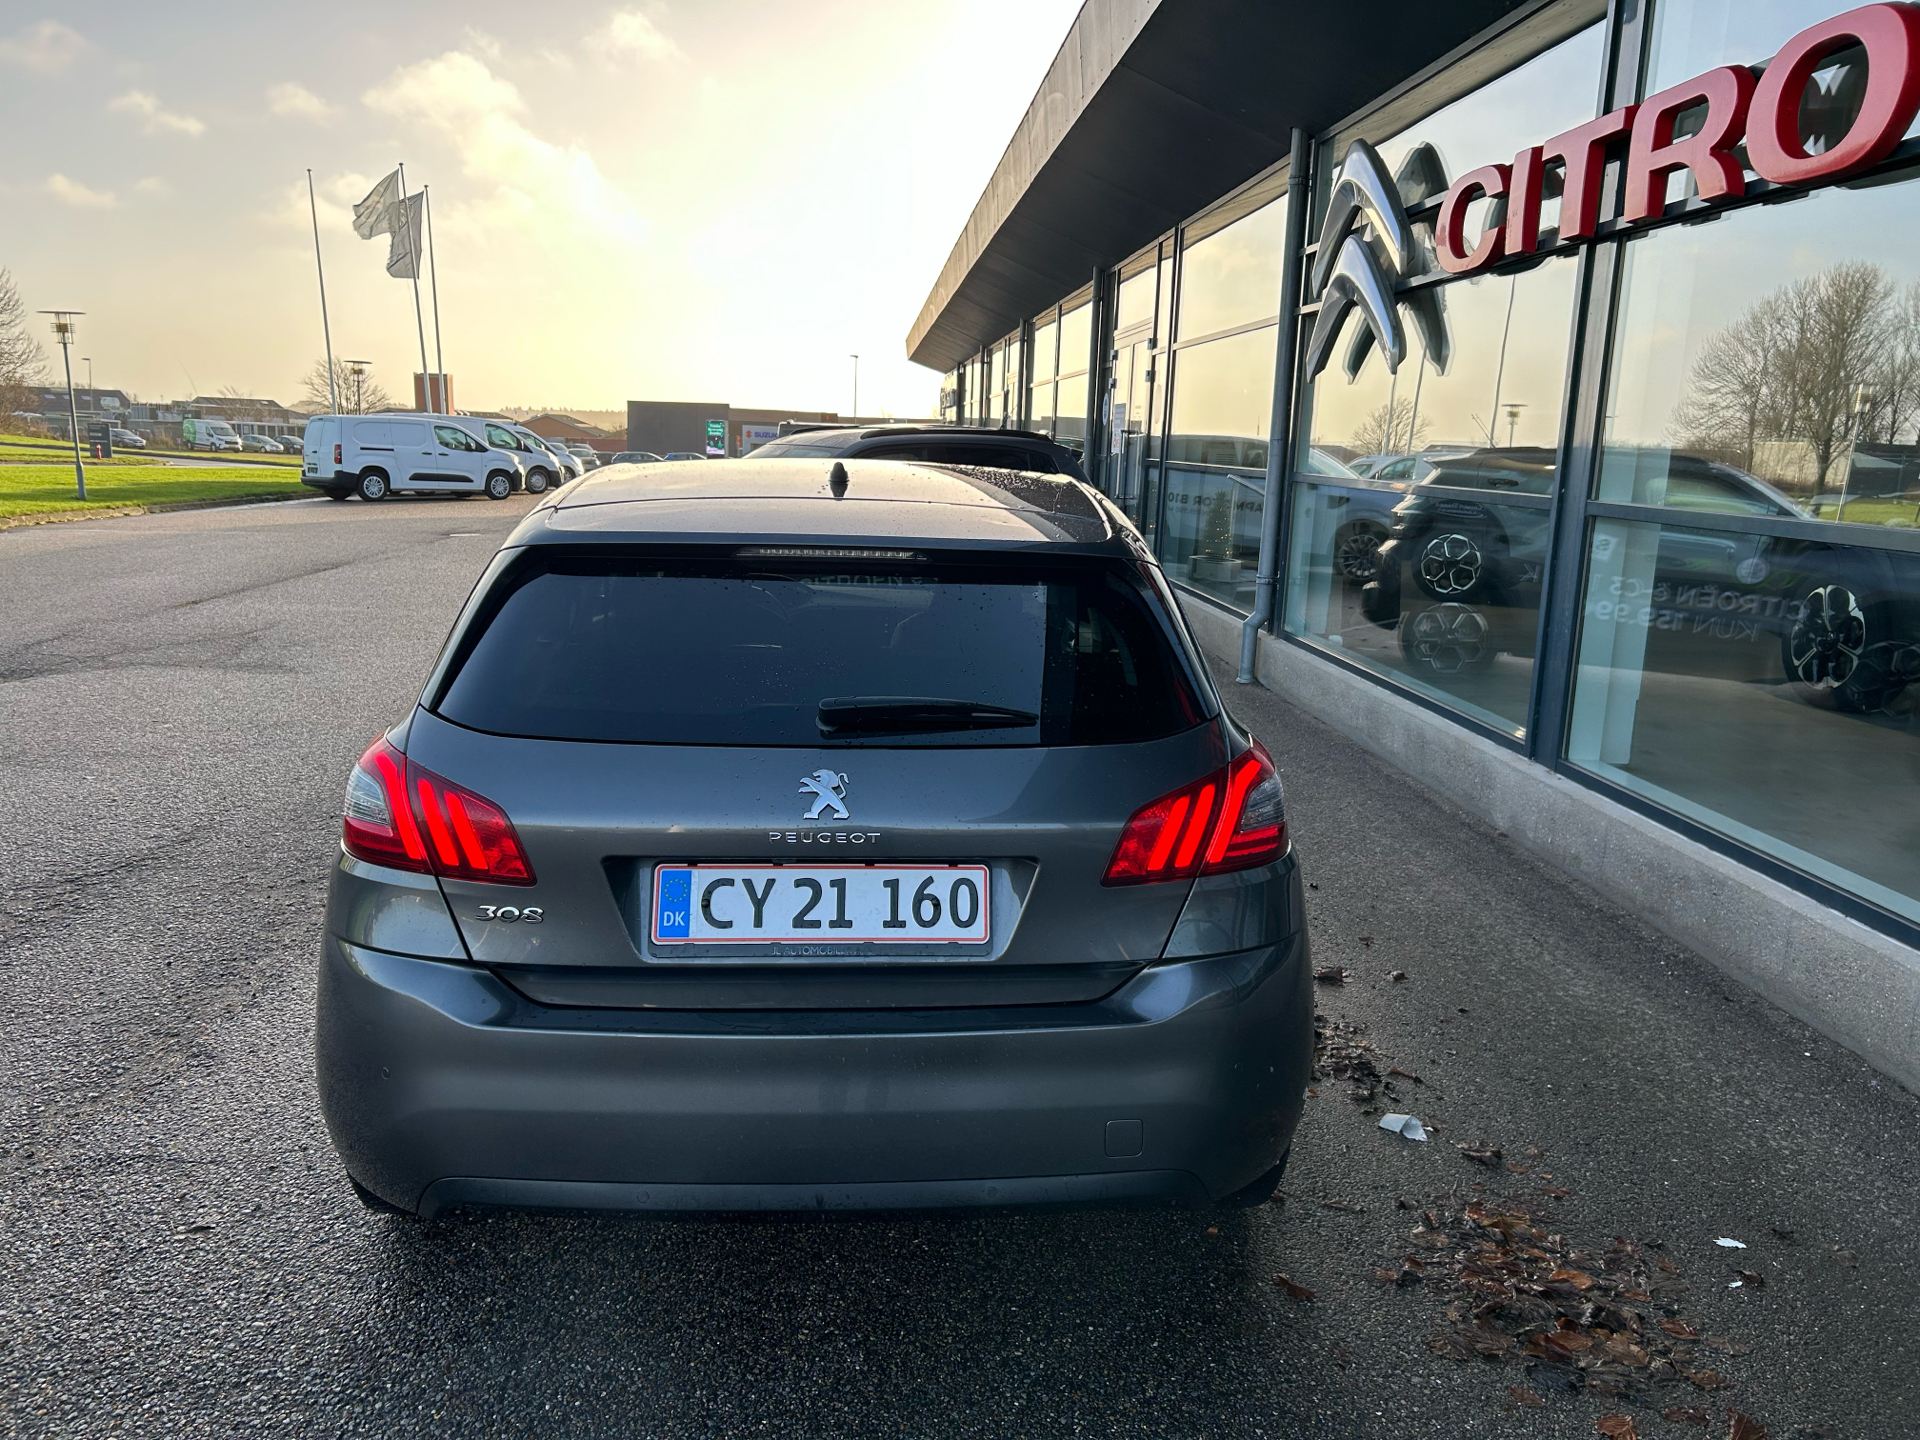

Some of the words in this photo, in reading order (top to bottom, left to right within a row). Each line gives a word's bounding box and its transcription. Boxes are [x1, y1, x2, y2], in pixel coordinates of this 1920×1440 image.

[1436, 2, 1920, 273] CITRO
[768, 832, 881, 844] PEUGEOT
[700, 877, 777, 930] CY
[791, 877, 853, 930] 21
[882, 876, 979, 929] 160
[475, 905, 544, 924] 308
[663, 911, 686, 928] DK
